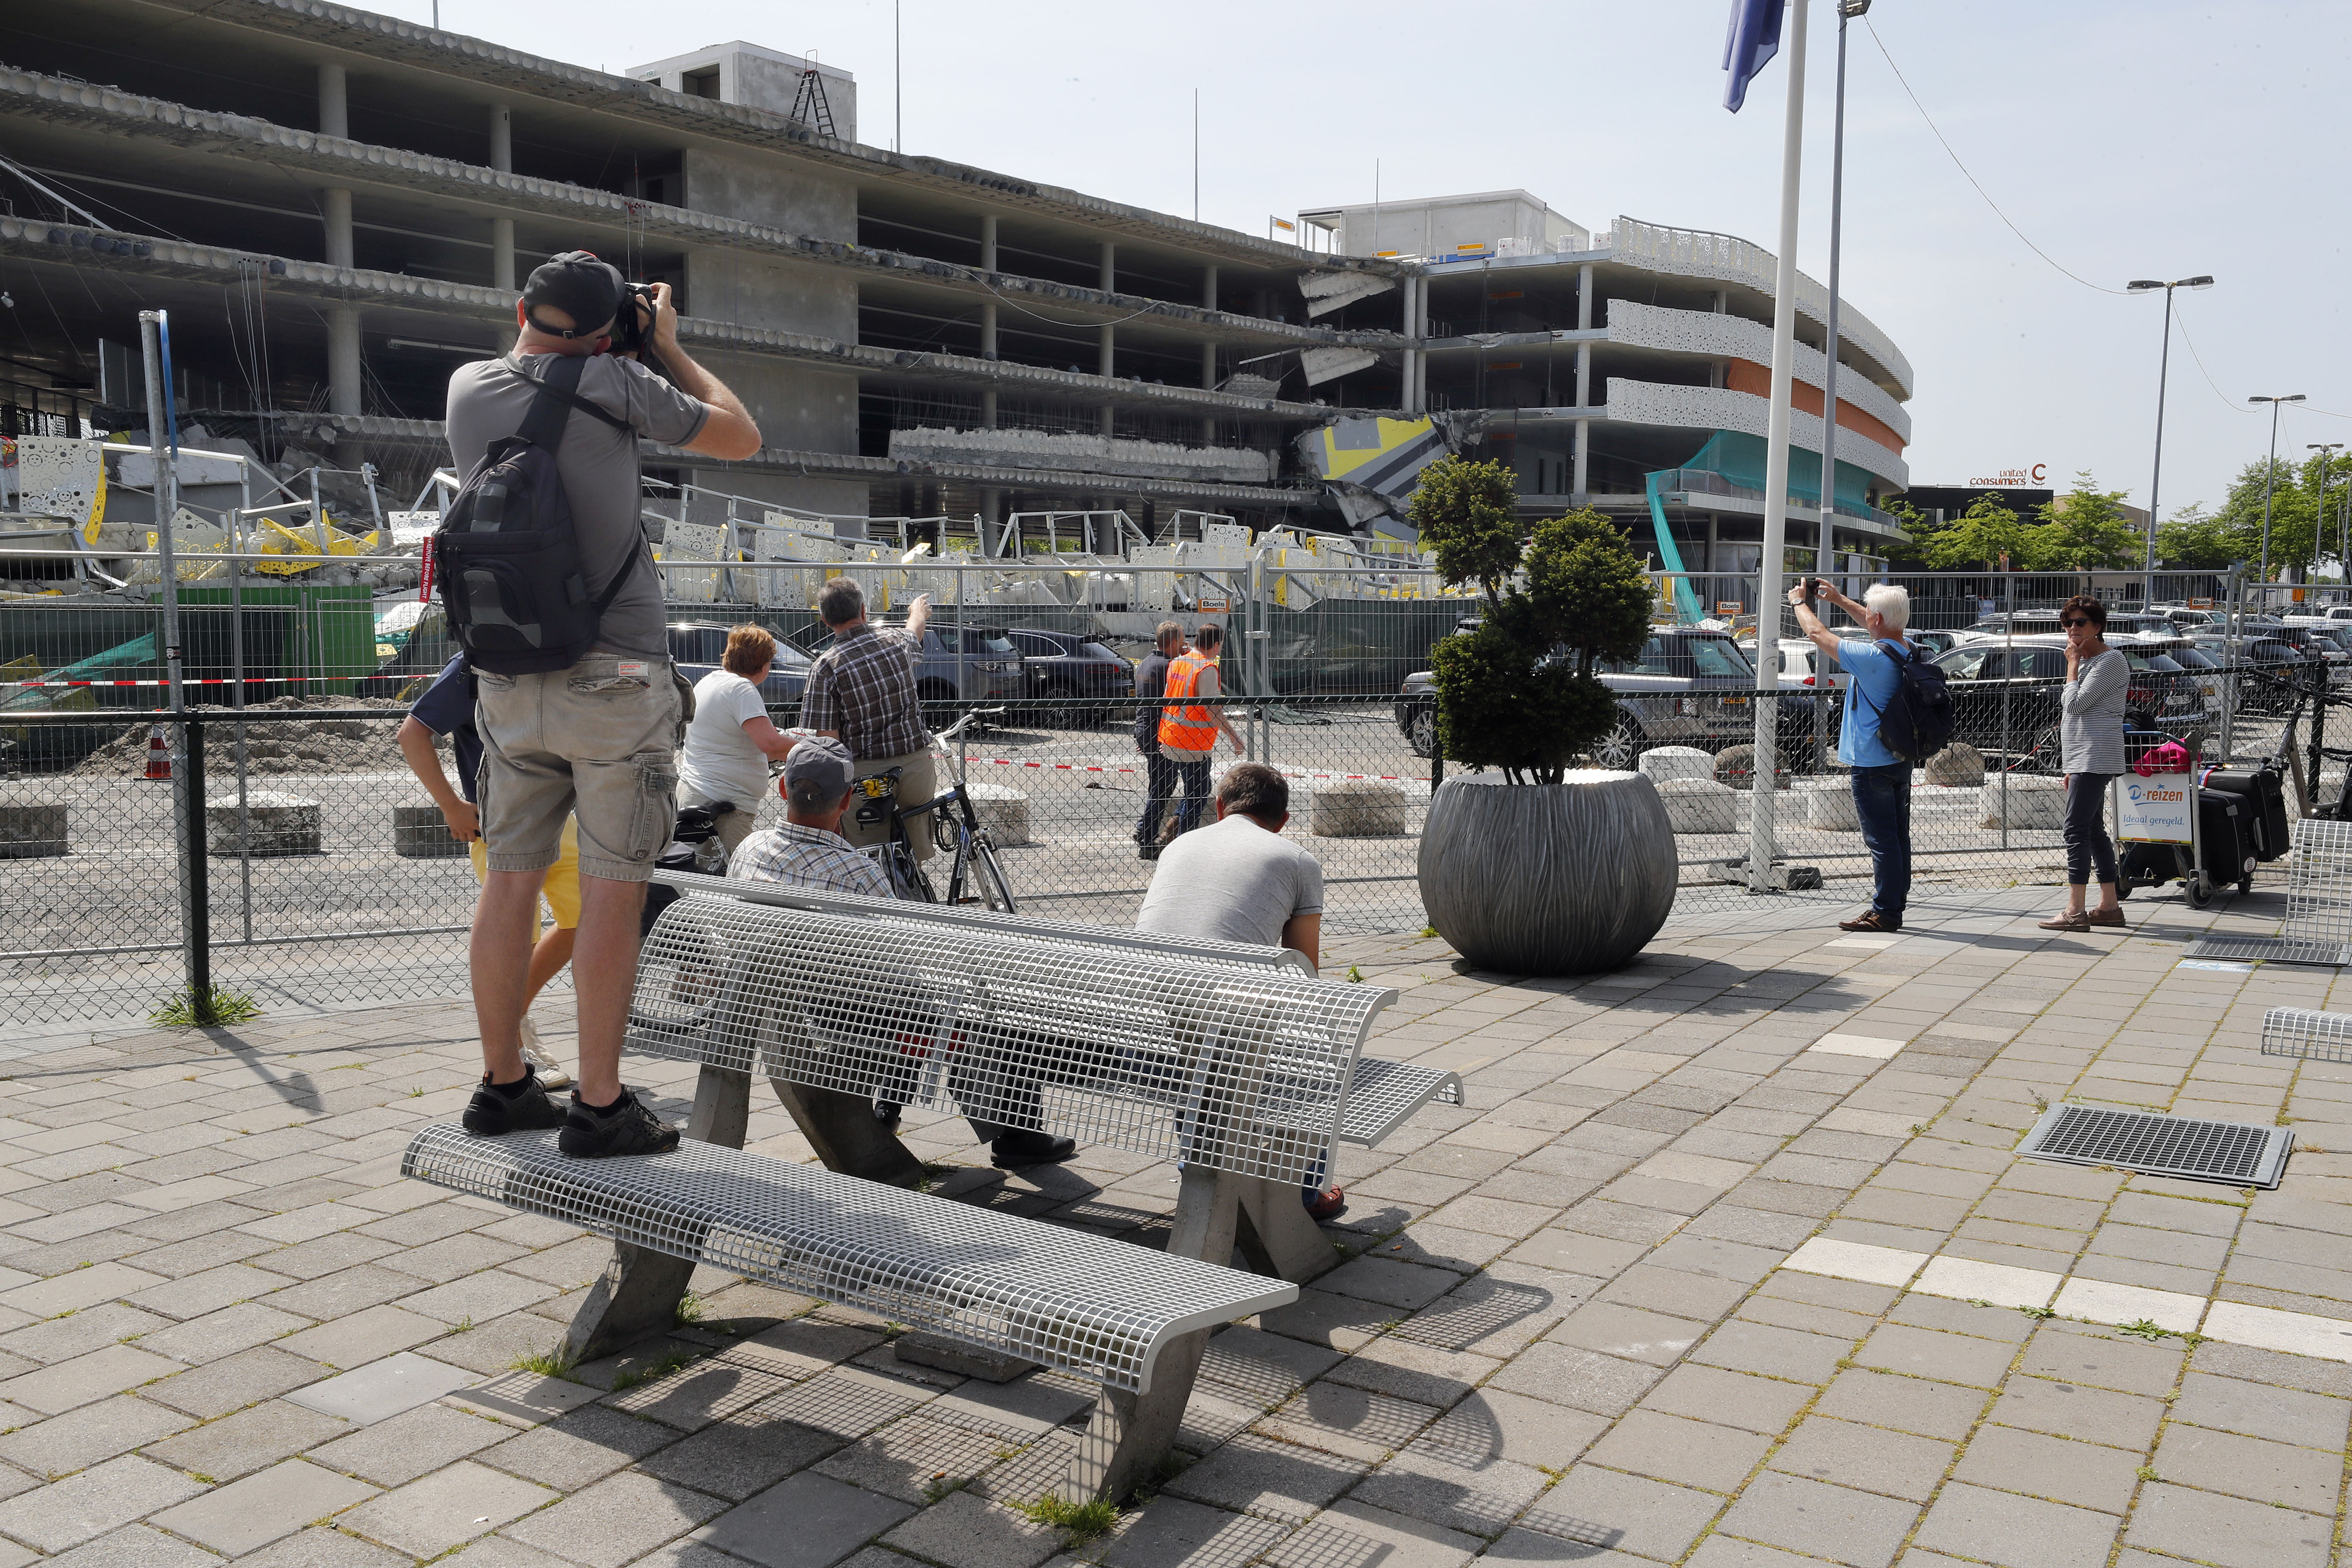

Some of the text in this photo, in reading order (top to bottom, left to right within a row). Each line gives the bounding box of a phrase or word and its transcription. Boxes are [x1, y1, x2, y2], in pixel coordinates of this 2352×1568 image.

[2000, 468, 2027, 477] united
[2123, 815, 2185, 827] Ideaal geregeld.
